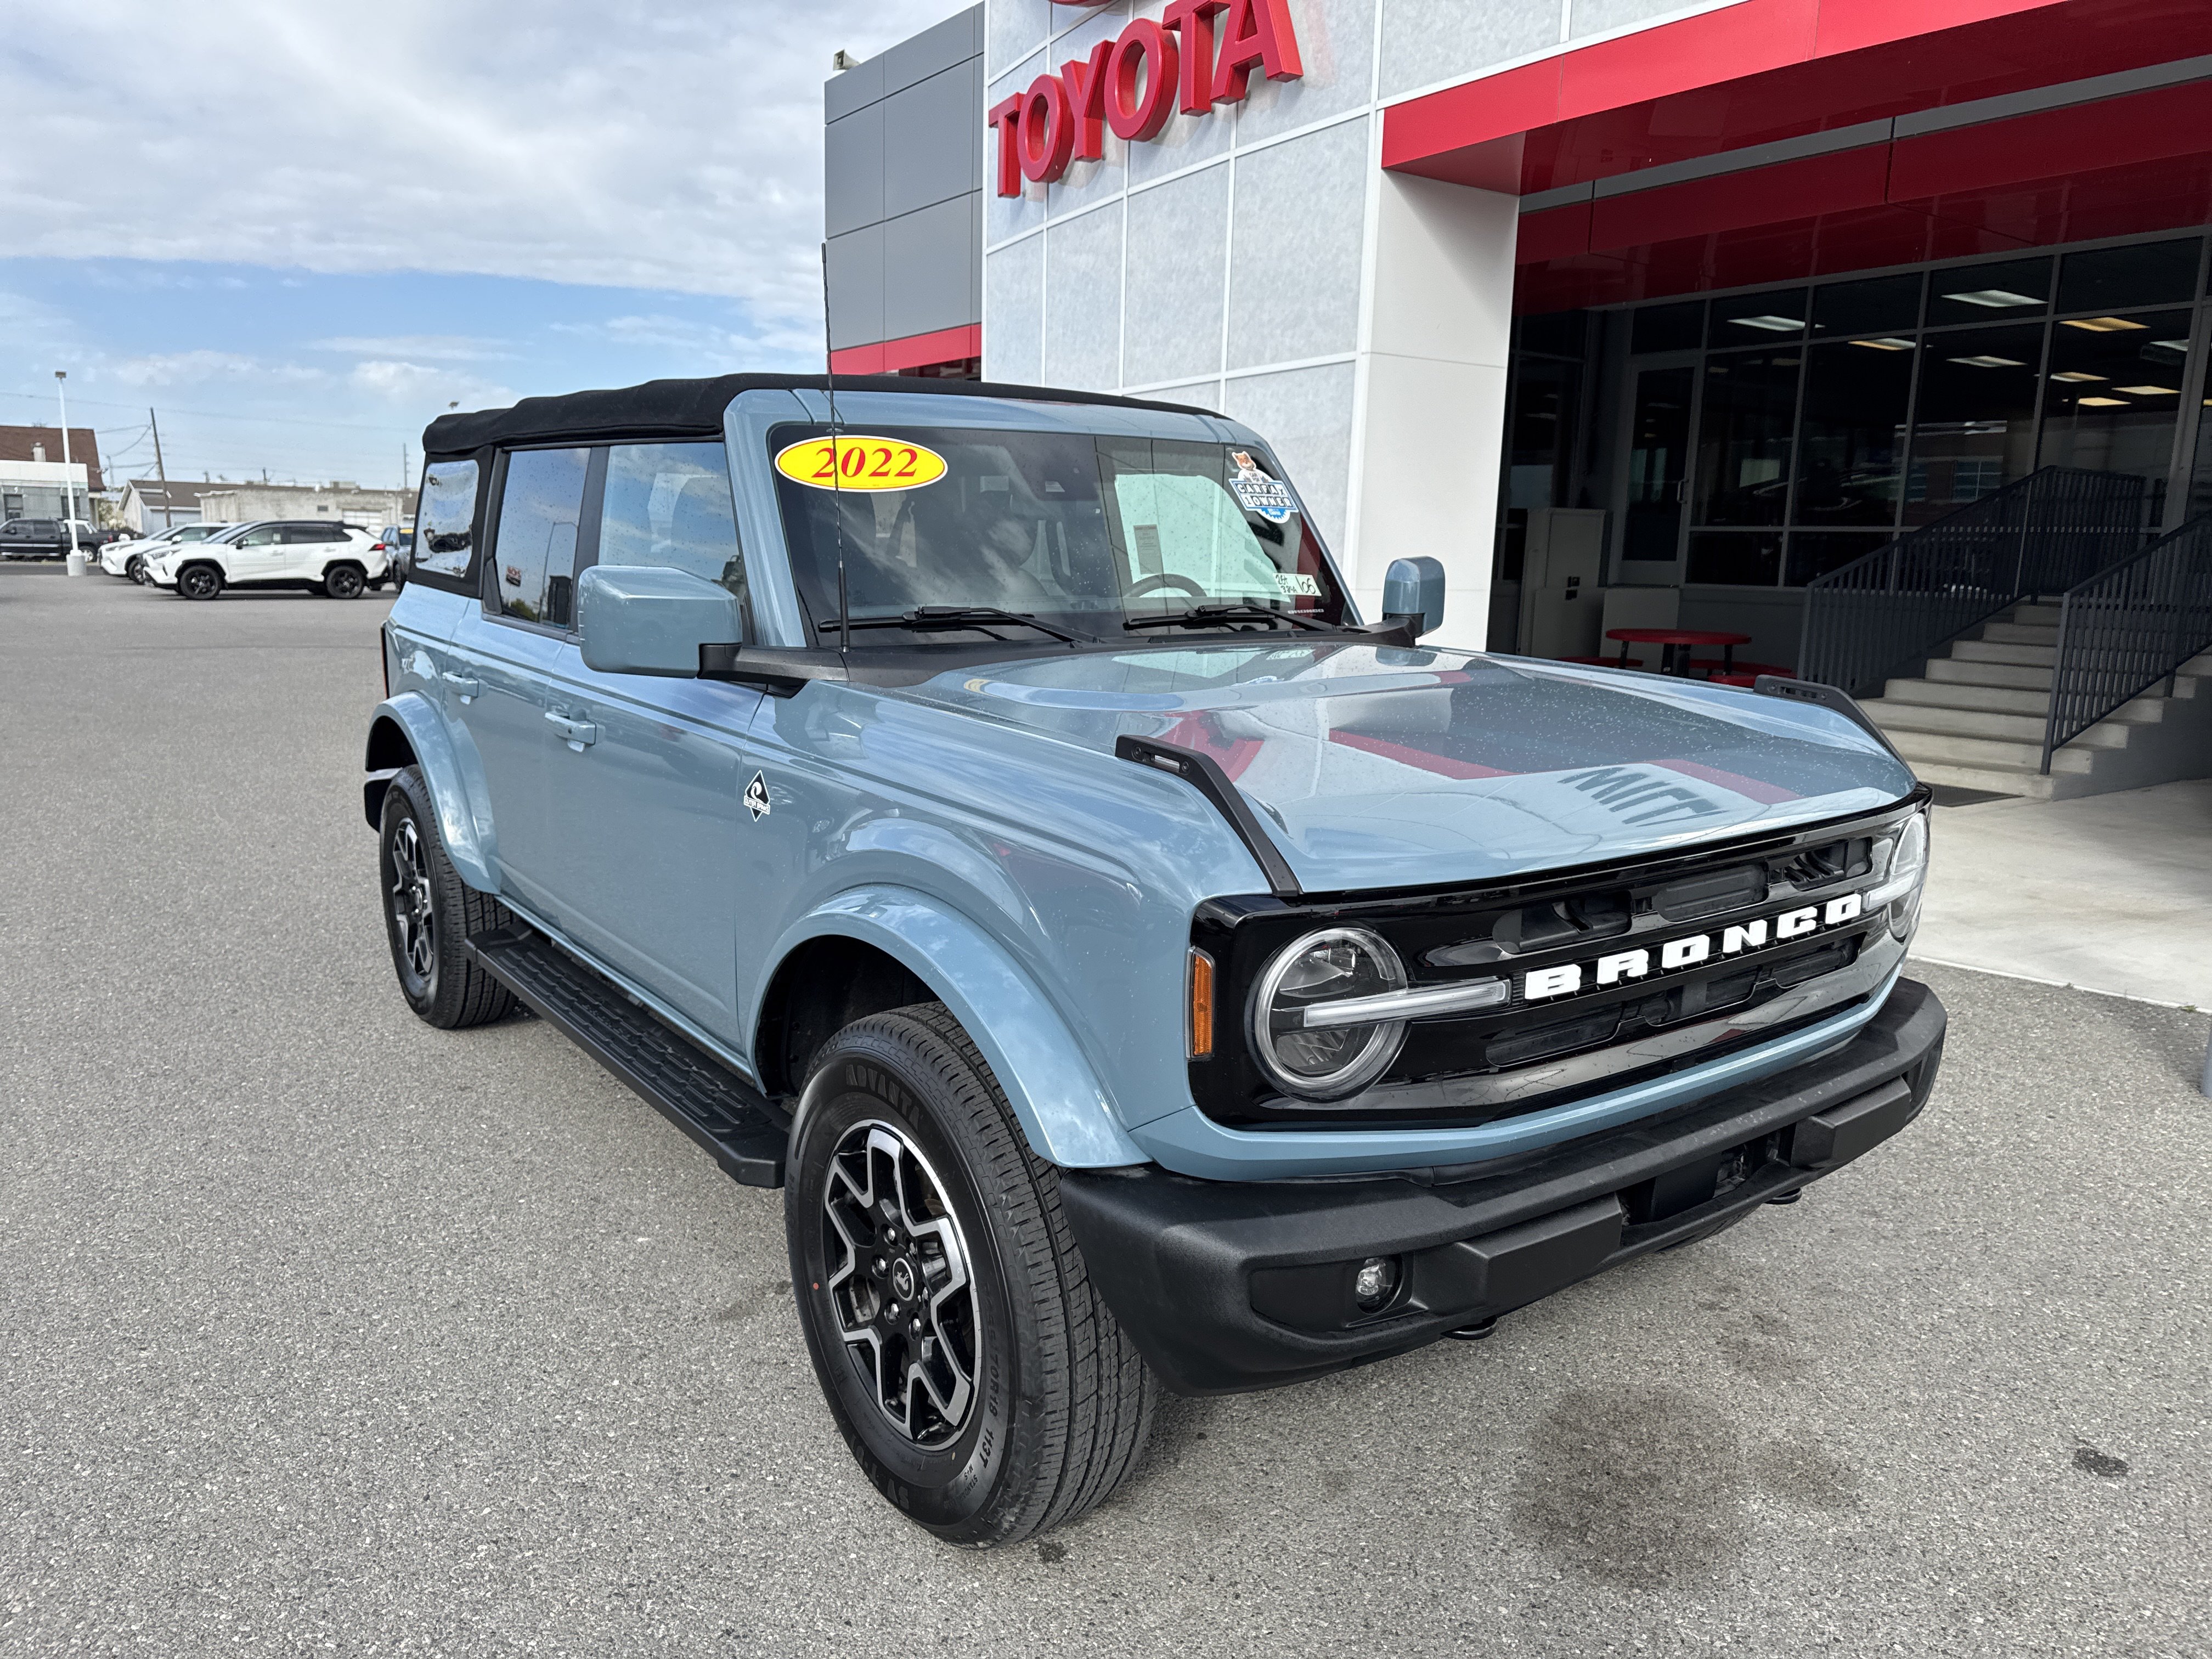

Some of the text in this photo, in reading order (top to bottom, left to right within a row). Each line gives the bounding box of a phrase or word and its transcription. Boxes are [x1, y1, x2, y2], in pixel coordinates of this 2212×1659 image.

[989, 0, 1304, 198] TOYOTA
[811, 447, 917, 477] 2022
[1237, 483, 1286, 496] CARFAX
[744, 797, 757, 808] OUTER
[1524, 894, 1861, 1000] BRONCO
[979, 1427, 995, 1469] 113T
